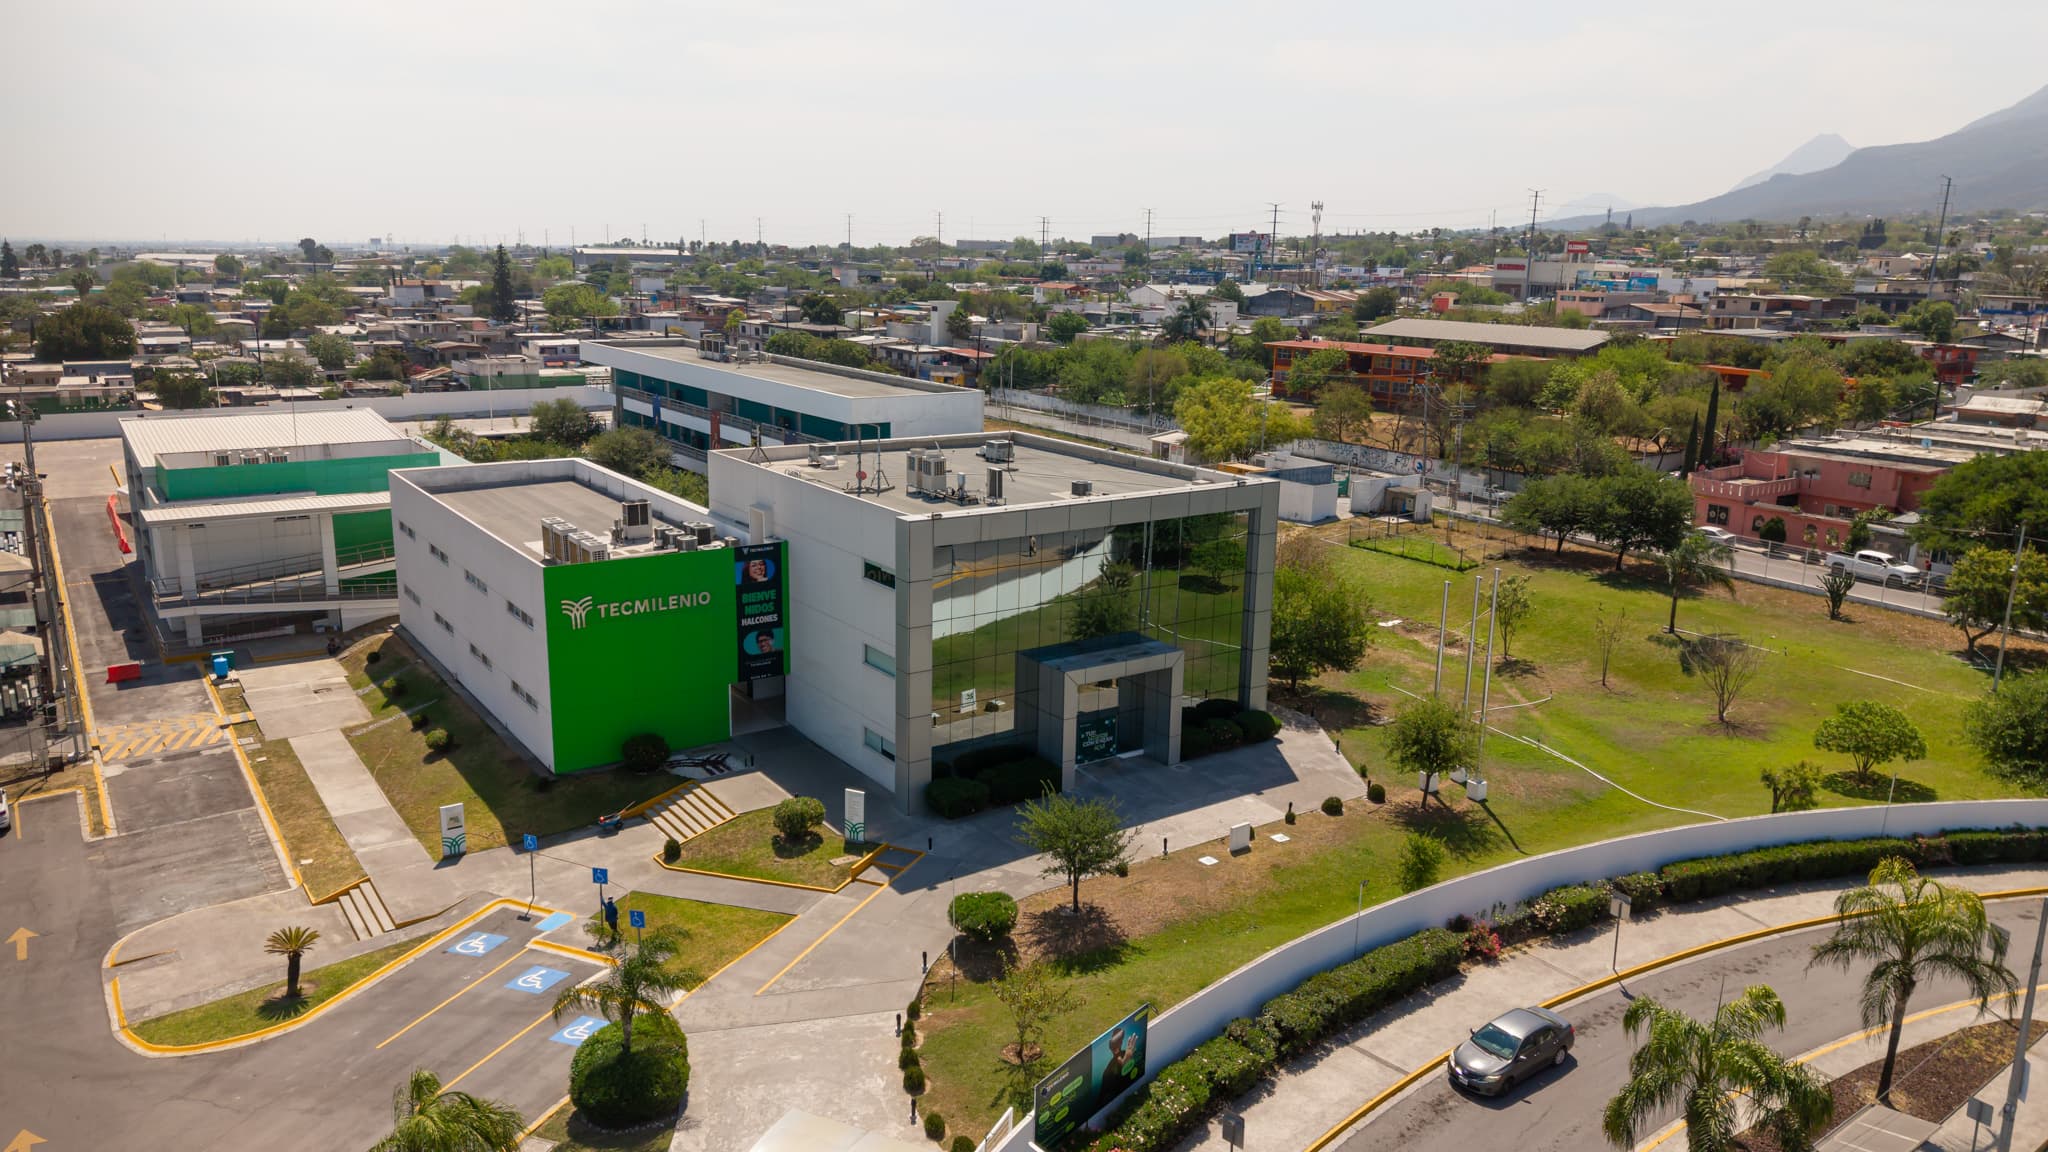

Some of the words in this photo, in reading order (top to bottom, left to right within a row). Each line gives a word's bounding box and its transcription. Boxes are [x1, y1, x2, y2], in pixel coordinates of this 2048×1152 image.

[742, 589, 776, 603] BIENVE
[597, 591, 711, 618] TECMILENIO
[745, 602, 774, 616] NIDOS
[741, 614, 778, 626] HALCONES
